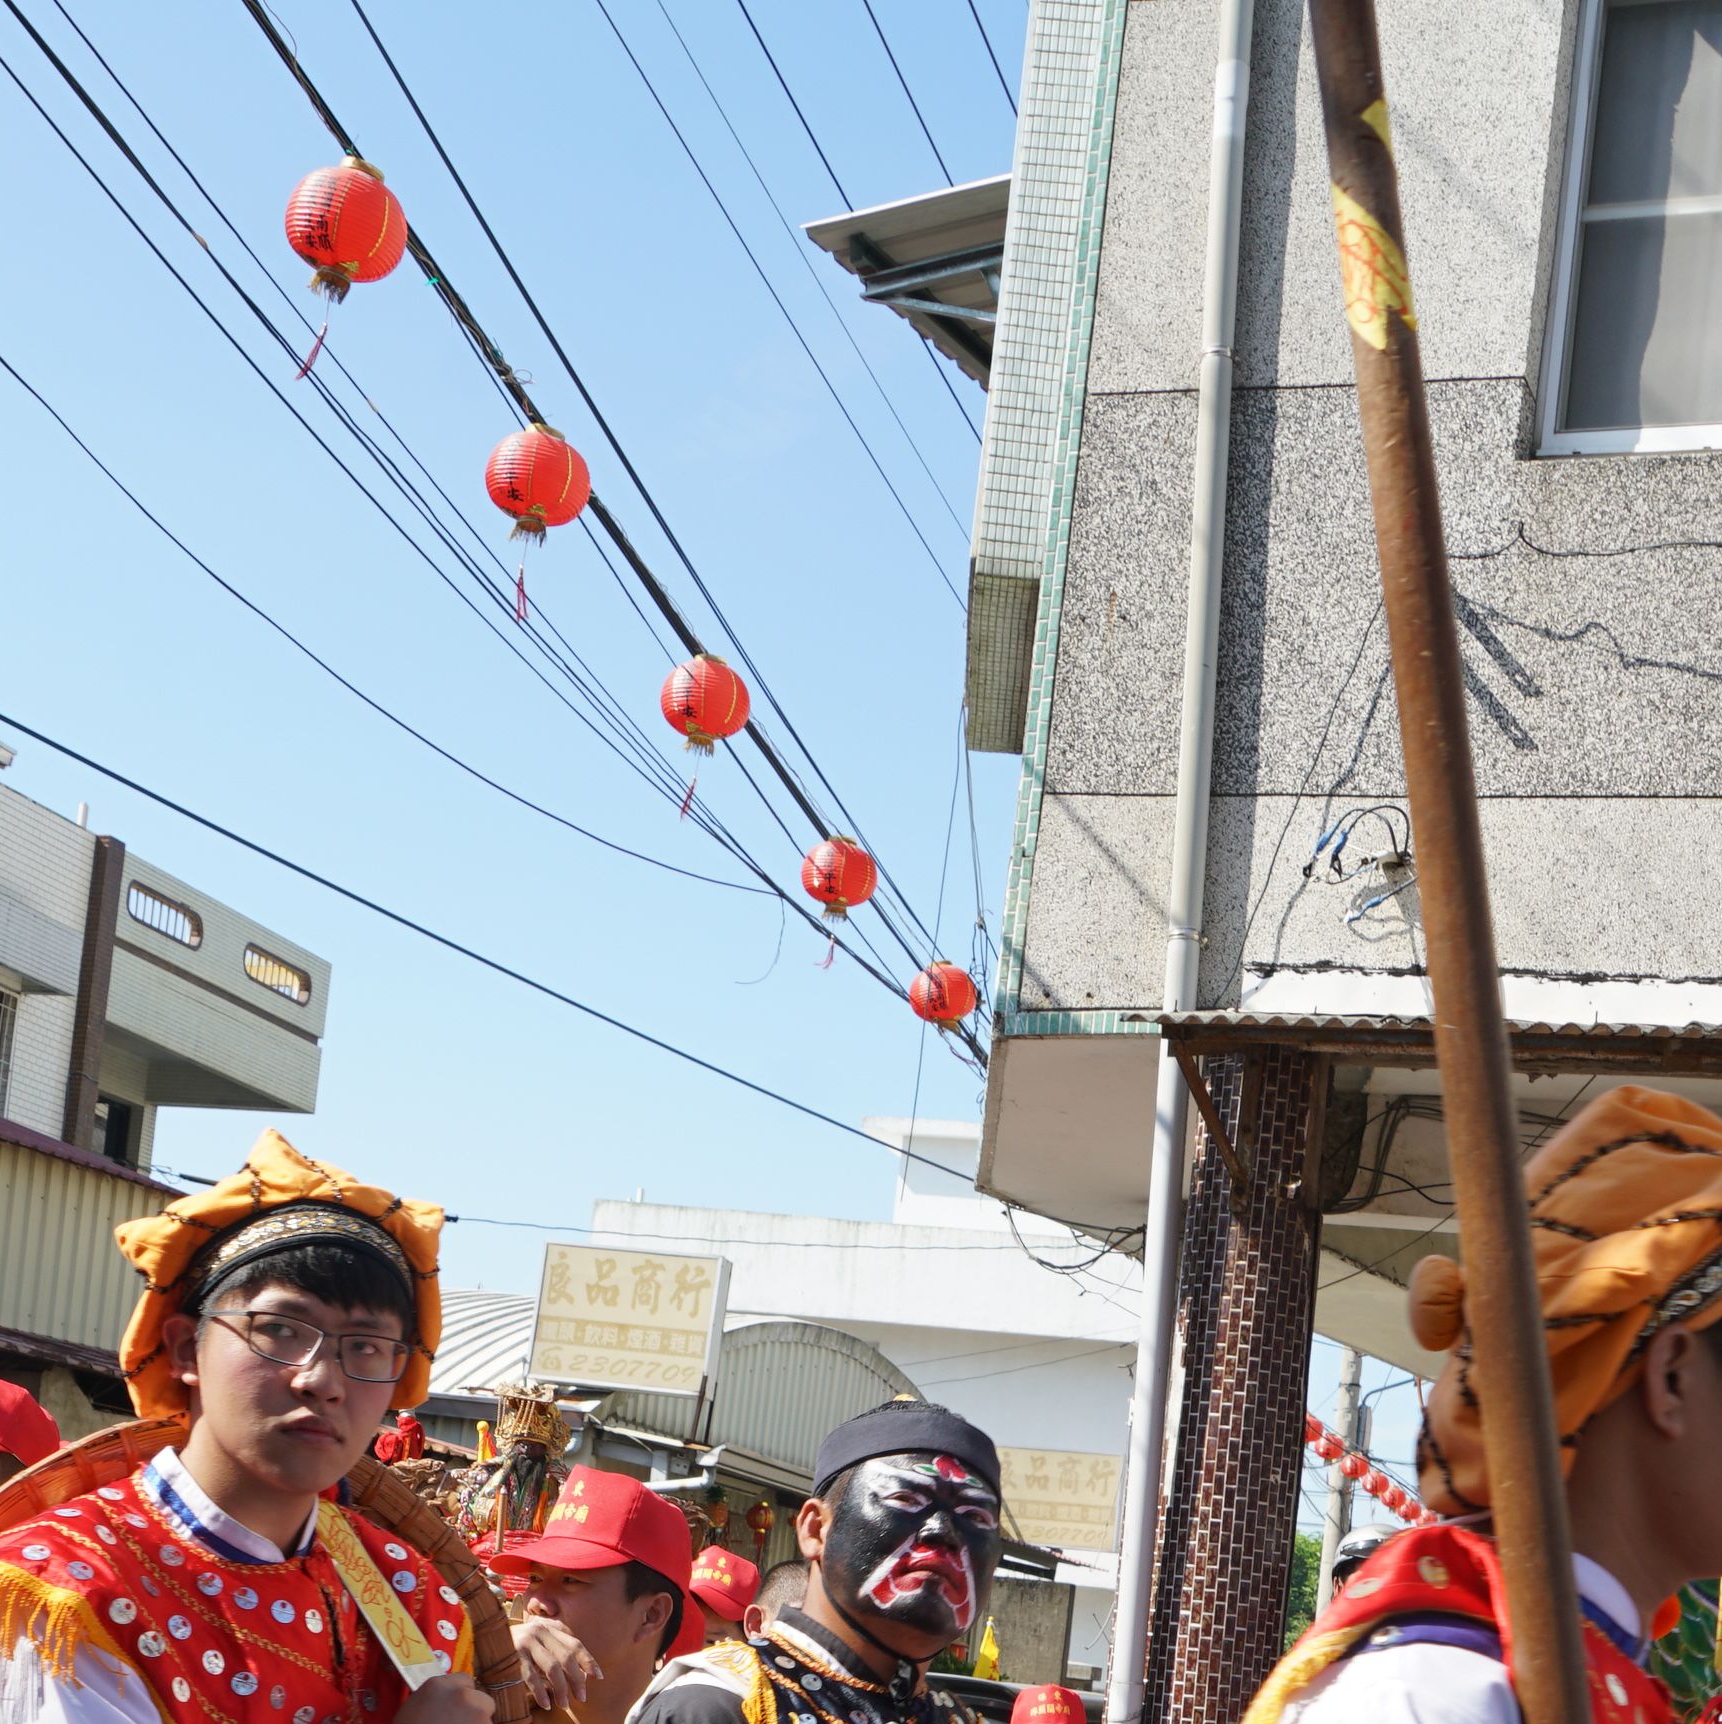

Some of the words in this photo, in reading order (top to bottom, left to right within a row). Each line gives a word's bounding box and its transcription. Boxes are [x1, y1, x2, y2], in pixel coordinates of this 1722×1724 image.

[546, 1250, 711, 1319] 良品商行
[568, 1354, 697, 1384] 2307709
